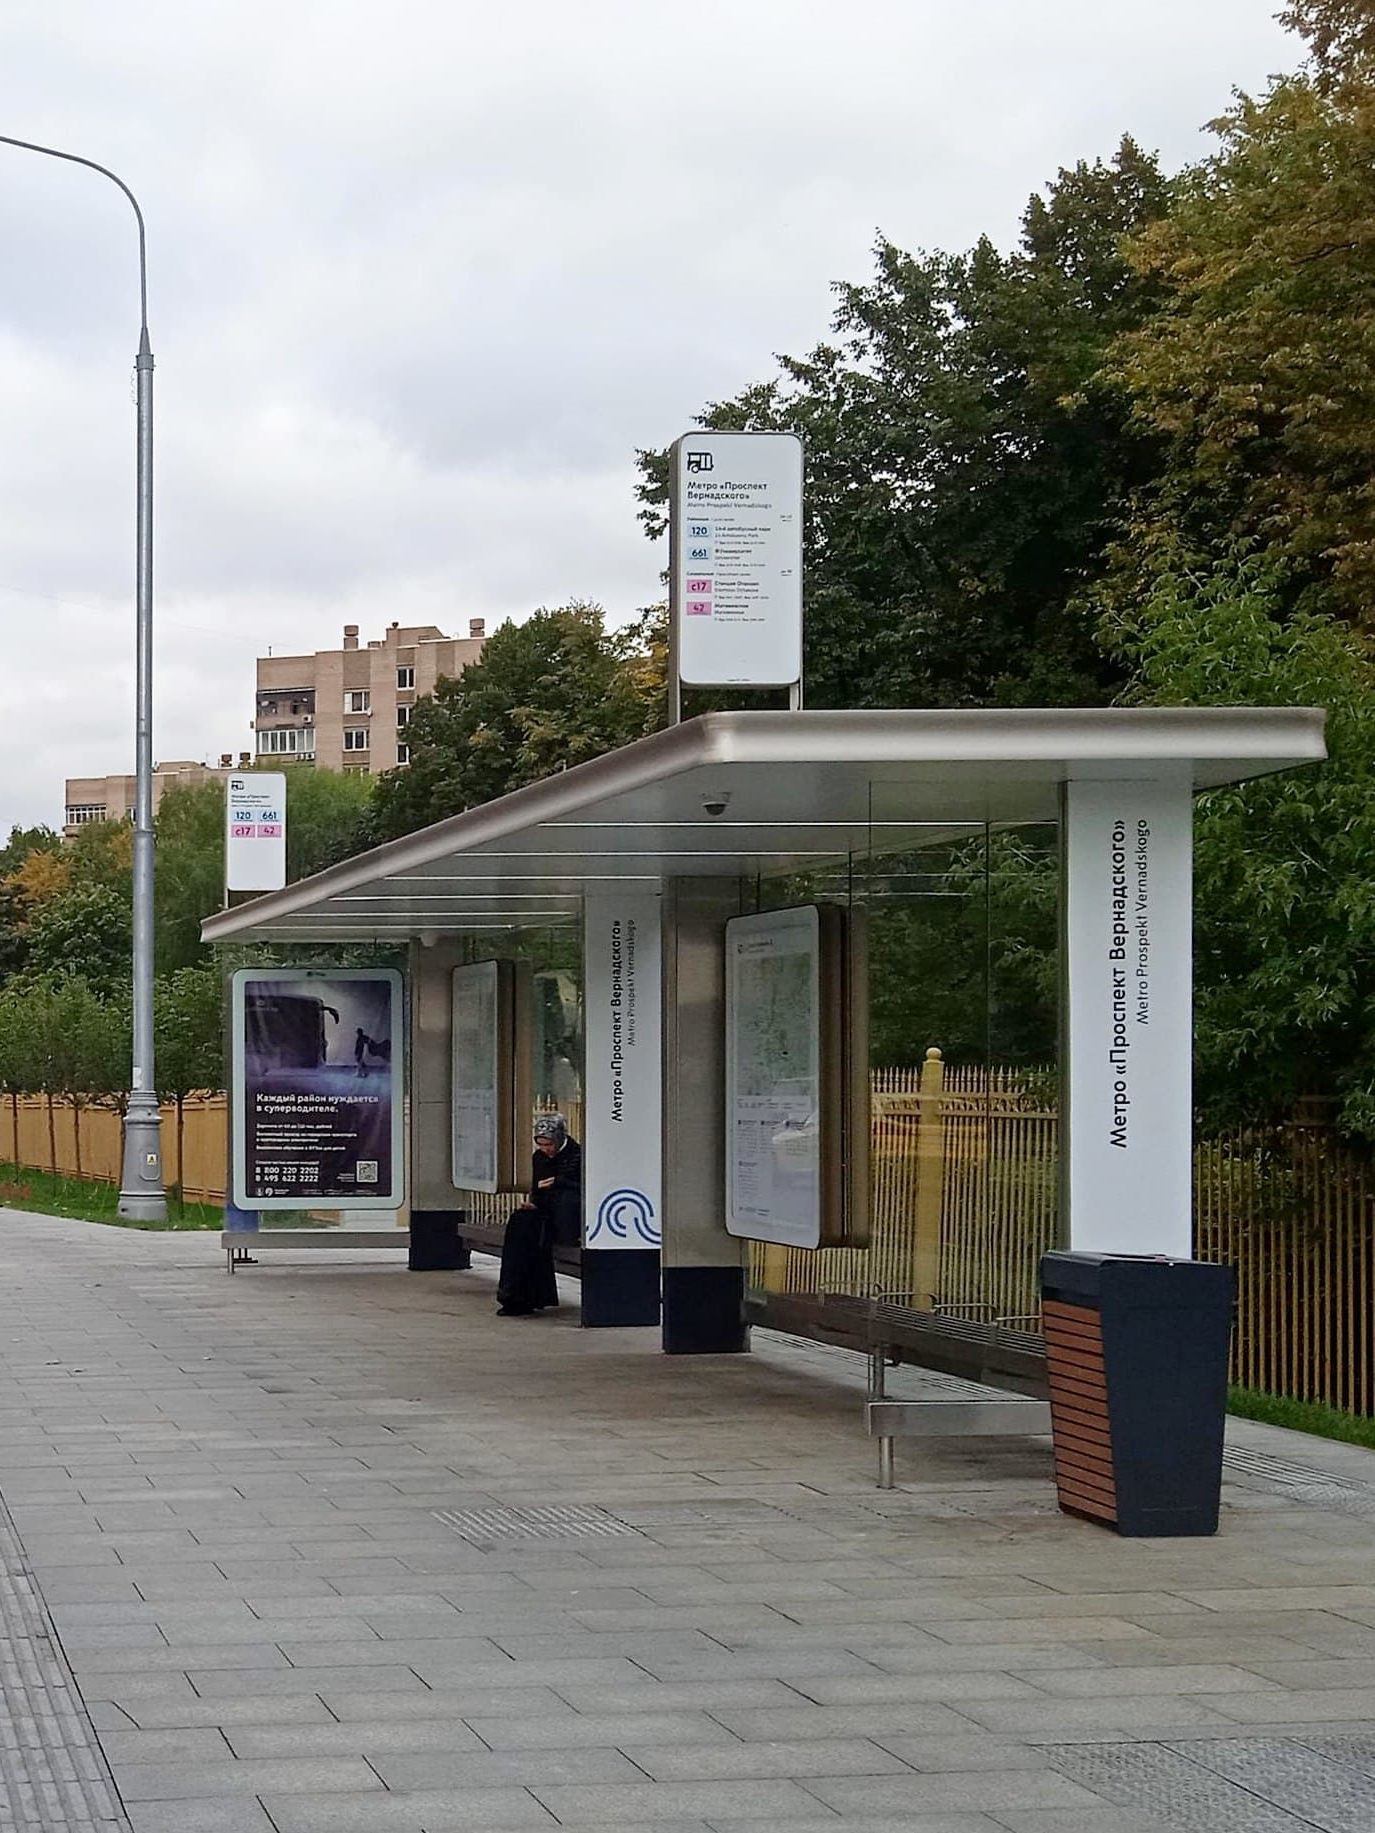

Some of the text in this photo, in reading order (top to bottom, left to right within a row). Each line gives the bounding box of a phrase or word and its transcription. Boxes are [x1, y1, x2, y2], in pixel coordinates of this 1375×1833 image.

[687, 481, 767, 491] Метро «Проспект
[687, 491, 750, 501] Вернадского»
[692, 526, 707, 535] 120
[691, 549, 707, 558] 661
[236, 811, 277, 819] 120 661
[1135, 819, 1151, 1025] Metro Prospekt Vernadskogo
[1109, 819, 1130, 1149] Метро «Проспект Вернадского»
[610, 920, 624, 1122] Метро «Проспект Вернадского»
[256, 1094, 378, 1105] Каждый район нуждается
